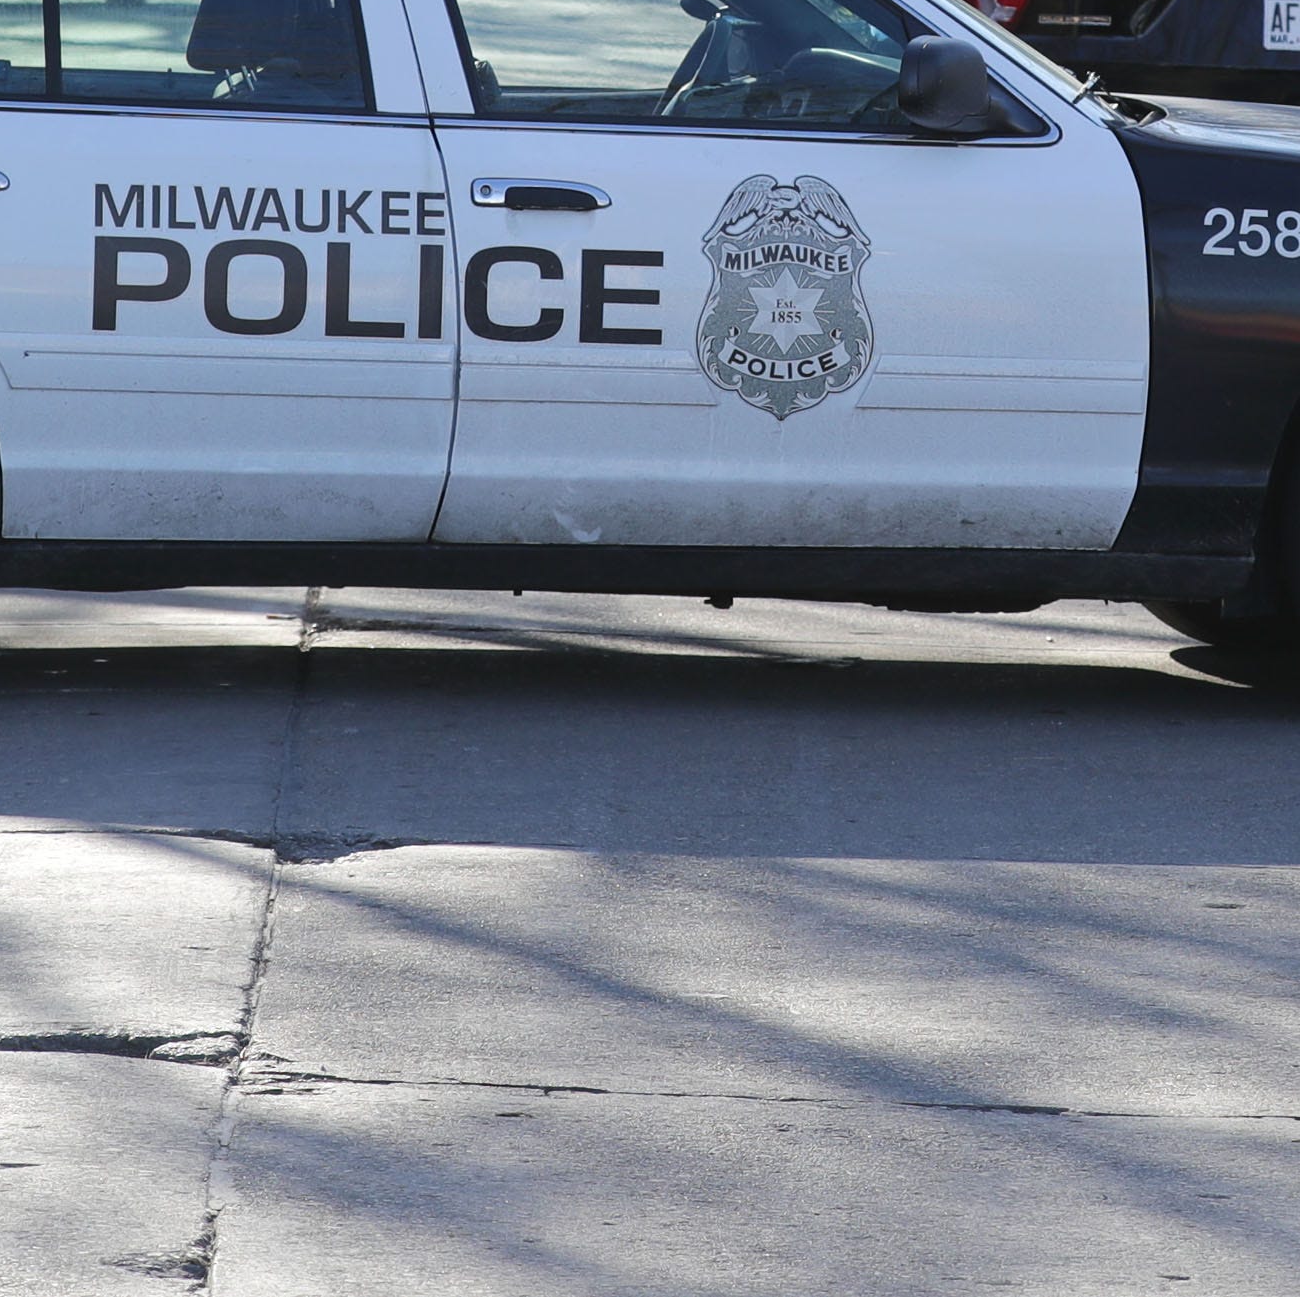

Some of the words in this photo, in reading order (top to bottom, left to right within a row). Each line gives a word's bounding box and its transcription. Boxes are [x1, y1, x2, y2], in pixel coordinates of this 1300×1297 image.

[93, 183, 447, 237] MILWAUKEE
[723, 243, 851, 273] MILWAUKEE
[91, 235, 665, 346] POLICE
[775, 298, 797, 310] Est.
[769, 310, 803, 324] 1855
[726, 349, 839, 380] POLICE
